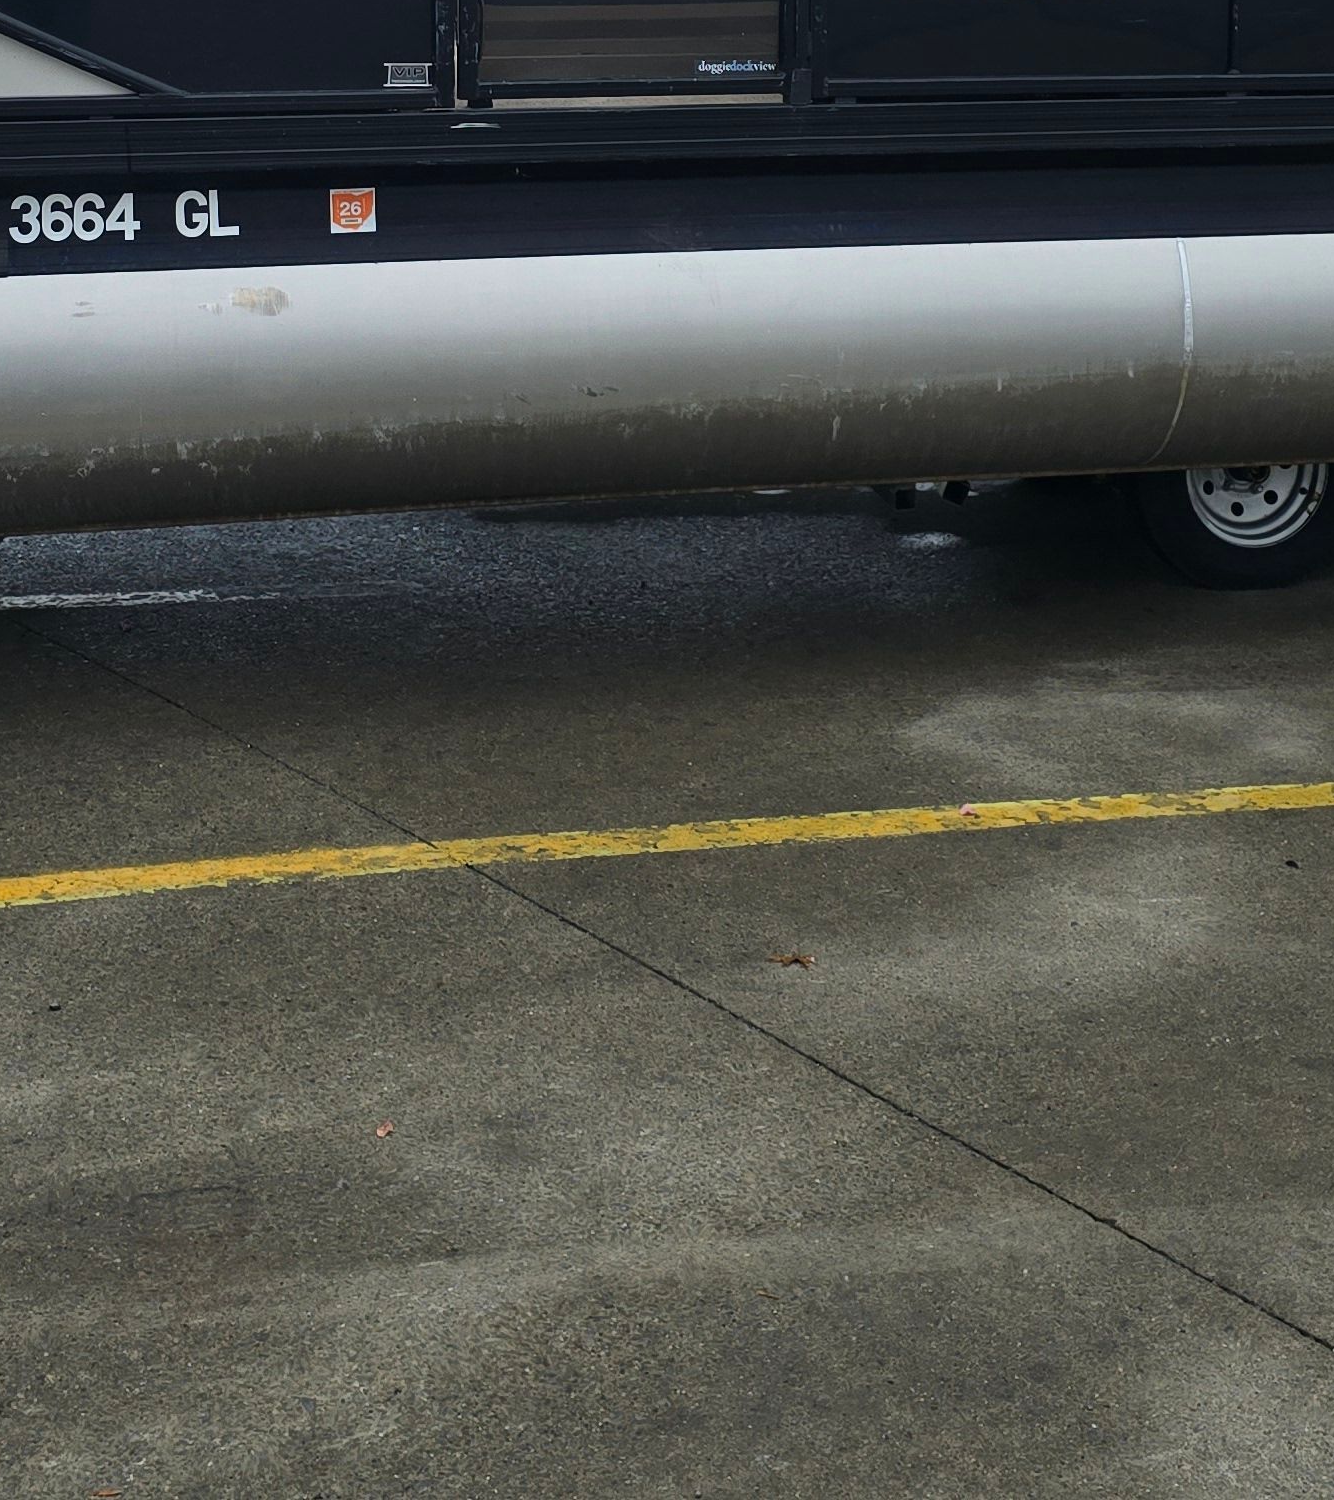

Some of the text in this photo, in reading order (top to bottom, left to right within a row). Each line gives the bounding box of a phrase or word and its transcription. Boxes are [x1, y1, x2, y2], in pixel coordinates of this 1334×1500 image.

[392, 66, 426, 78] VIP
[698, 60, 776, 75] doggiedockview
[339, 201, 362, 216] 26
[8, 192, 141, 244] 3664
[175, 189, 240, 238] GL
